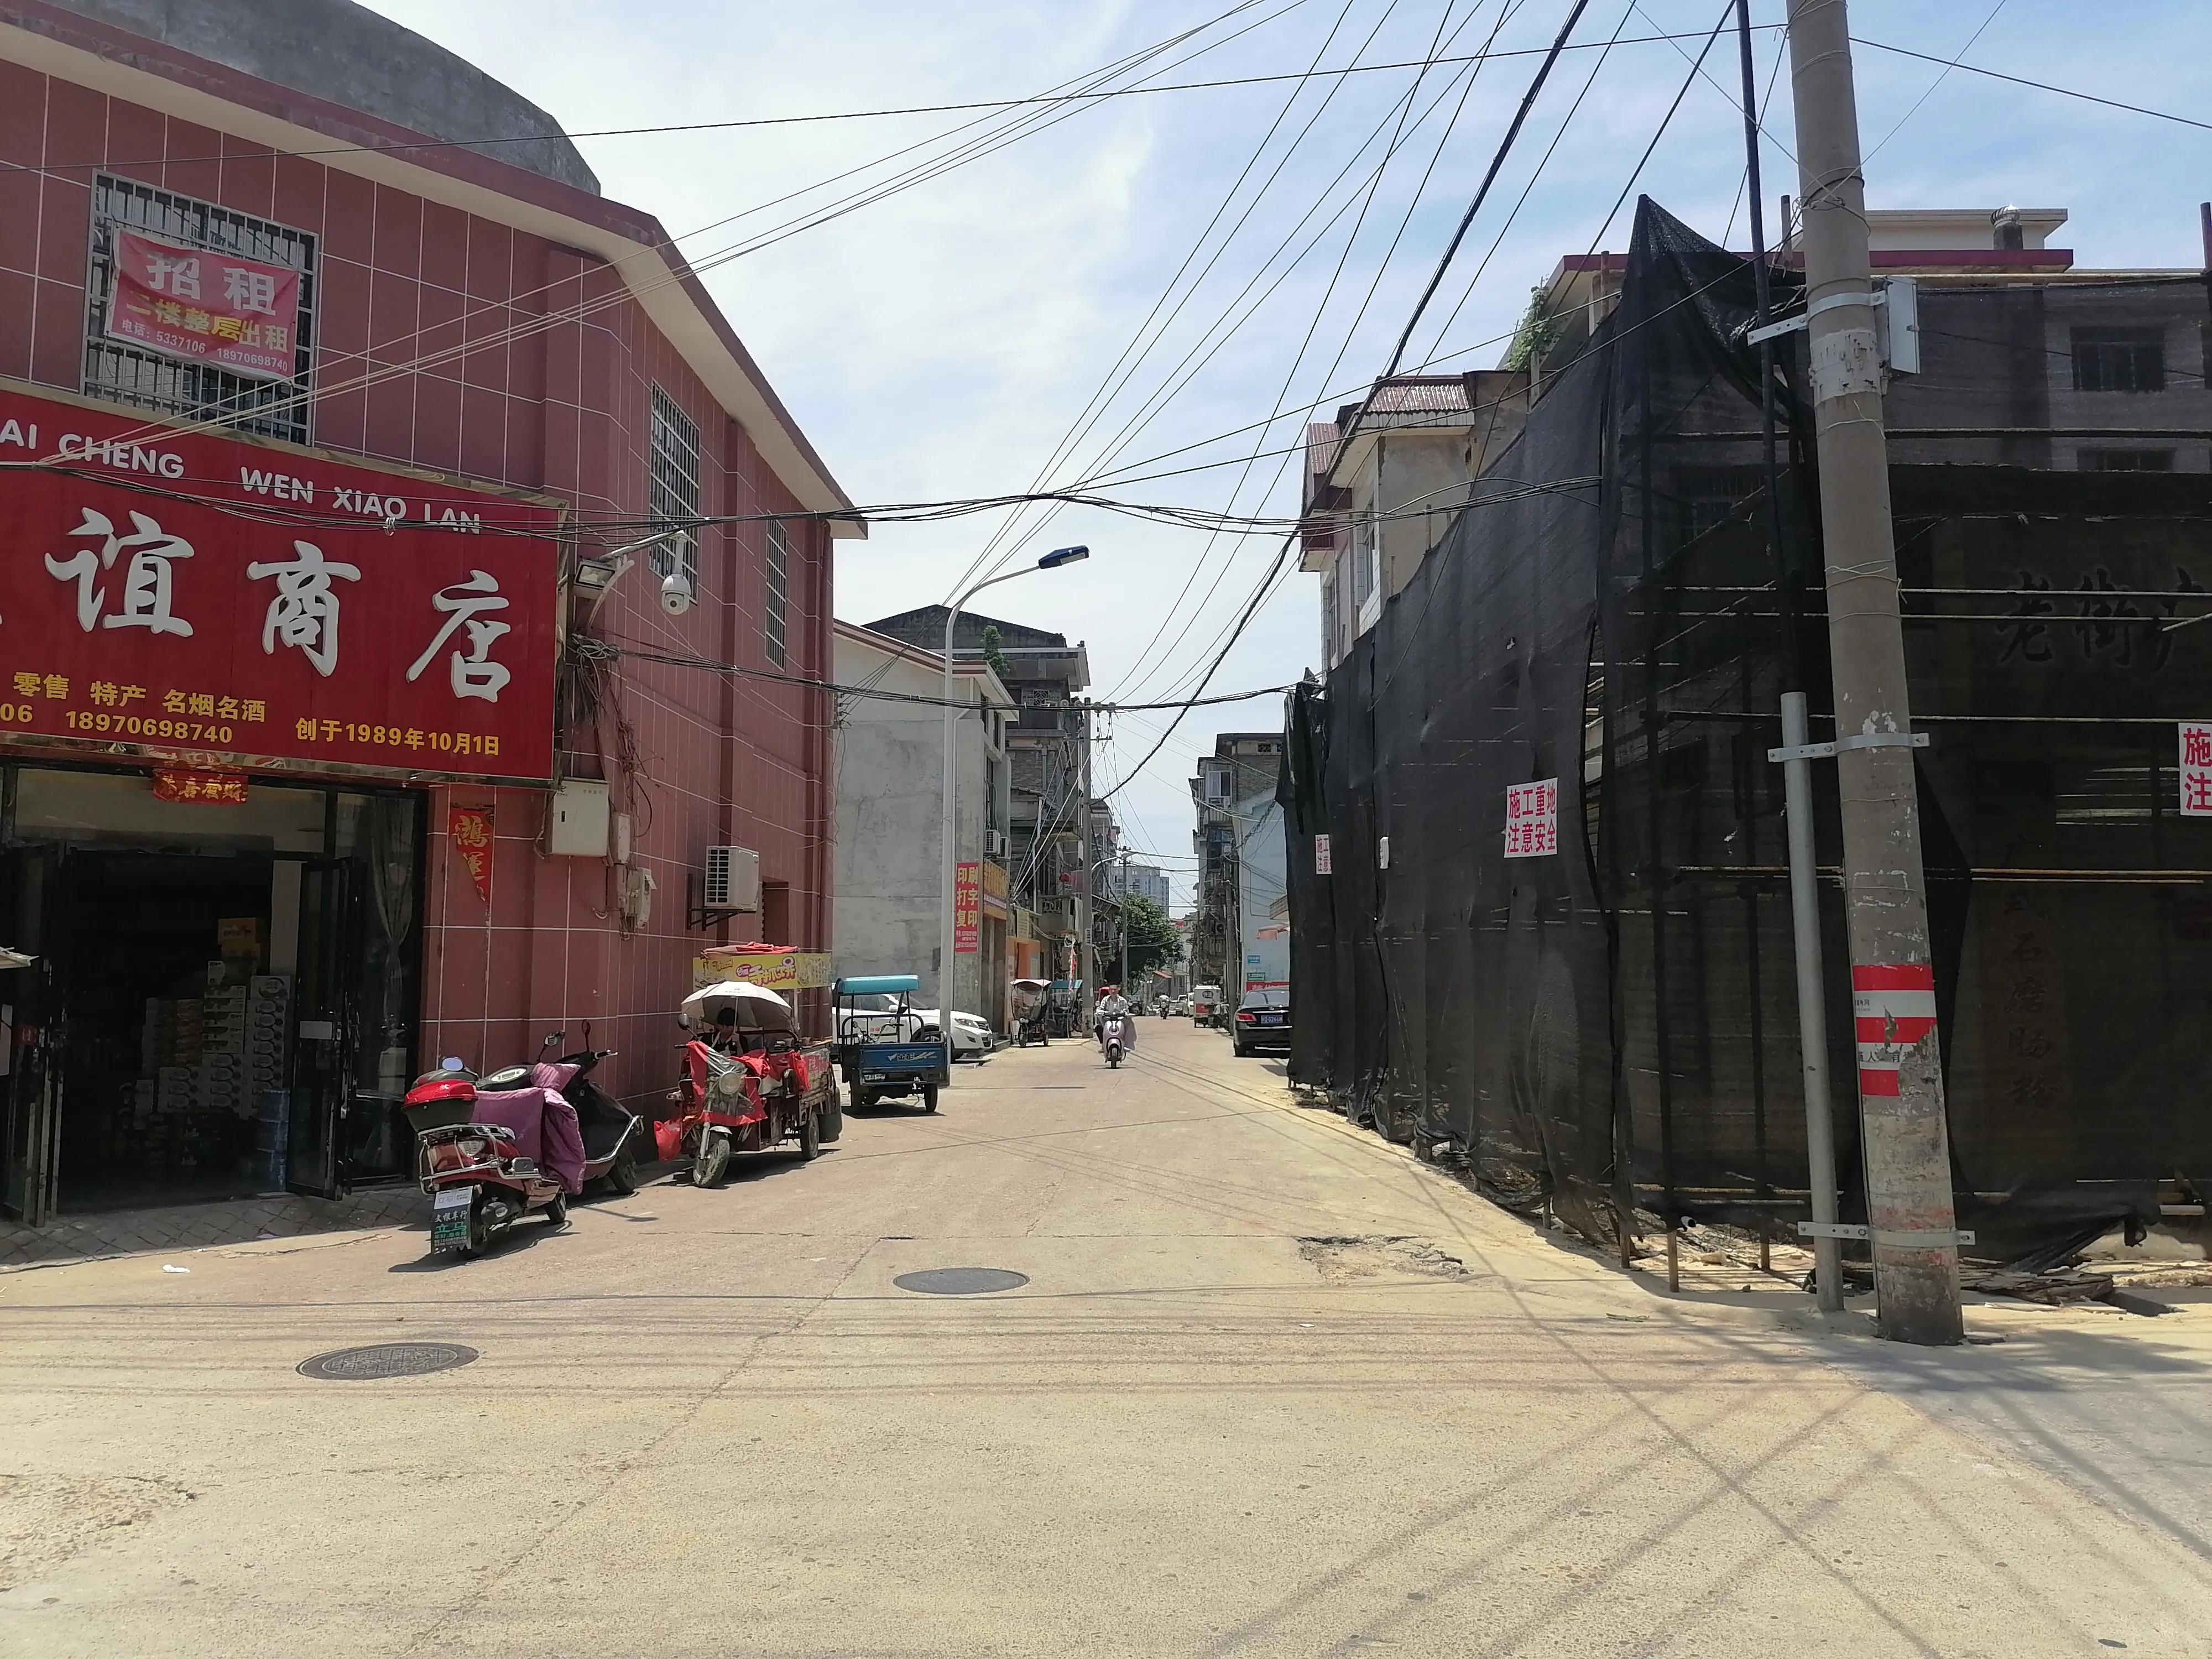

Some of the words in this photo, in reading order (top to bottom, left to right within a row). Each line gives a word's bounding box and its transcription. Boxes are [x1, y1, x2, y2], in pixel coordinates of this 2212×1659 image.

[146, 253, 276, 316] 招租
[126, 293, 288, 353] 二楼整层出租
[217, 348, 288, 372] 18970698740
[59, 434, 184, 479] CHENG
[240, 466, 313, 504] WEN
[333, 486, 407, 520] XIAO
[424, 503, 480, 535] LAN
[13, 671, 70, 700] 零售
[90, 680, 147, 707] 特产
[161, 688, 266, 723] 名烟名酒
[65, 710, 233, 744] 18970698740
[295, 717, 499, 756] 创于1989年10月1日
[1509, 781, 1556, 819] 施工重地
[1507, 818, 1556, 853] 注意安全
[957, 867, 978, 884] 印刷
[957, 888, 978, 906] 打字
[956, 909, 977, 927] 复印
[434, 1221, 467, 1234] 立马
